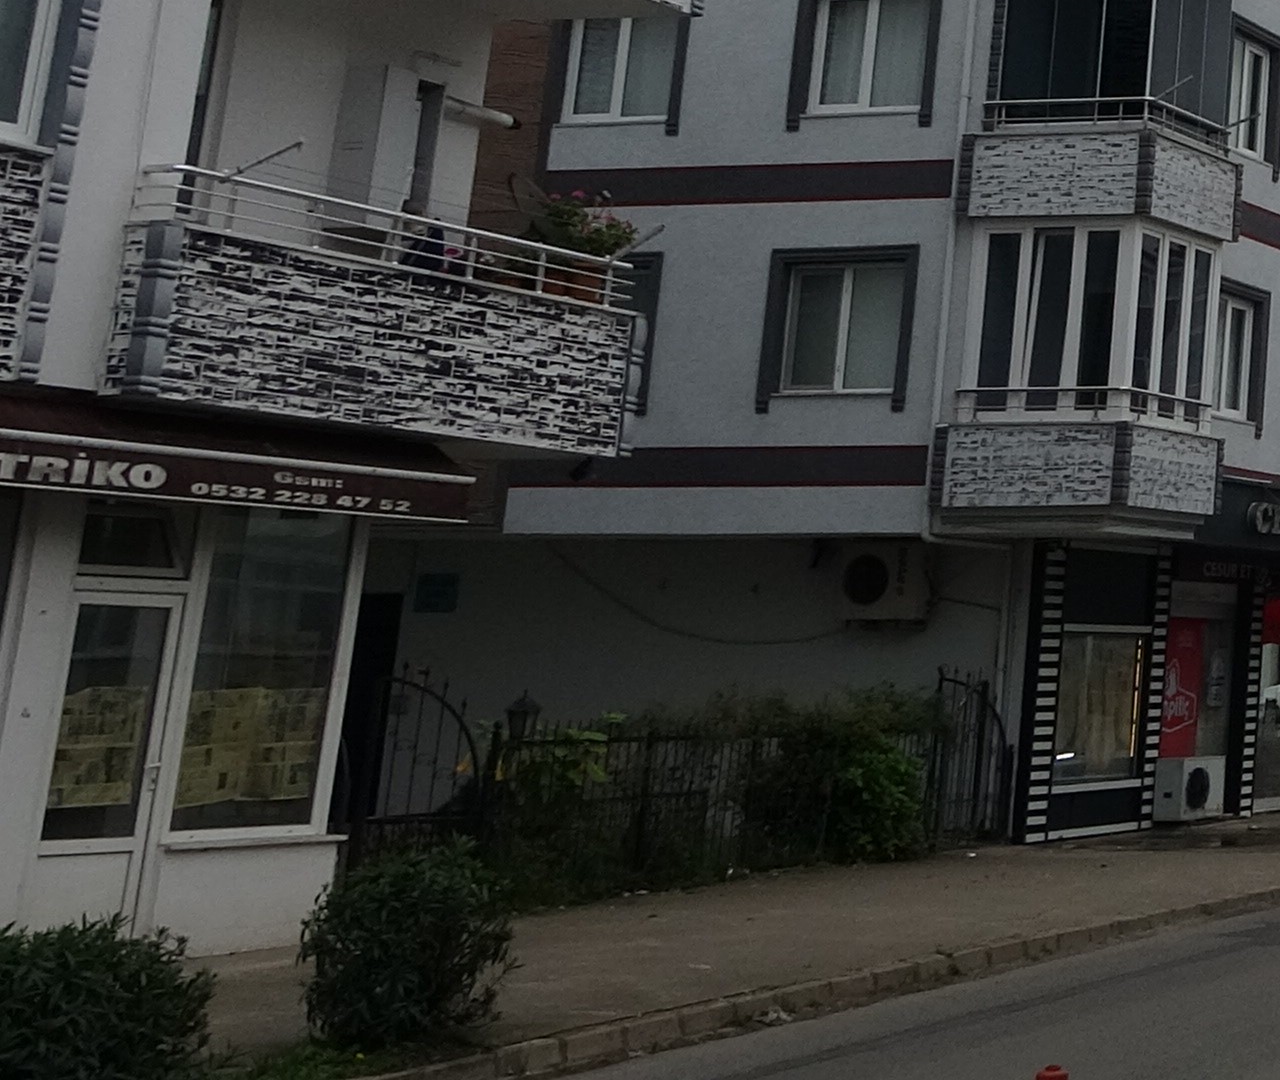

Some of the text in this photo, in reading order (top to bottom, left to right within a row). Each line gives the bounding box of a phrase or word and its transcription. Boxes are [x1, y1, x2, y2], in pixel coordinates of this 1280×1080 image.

[190, 482, 266, 500] 0532
[336, 495, 371, 509] 47
[378, 498, 411, 512] 52
